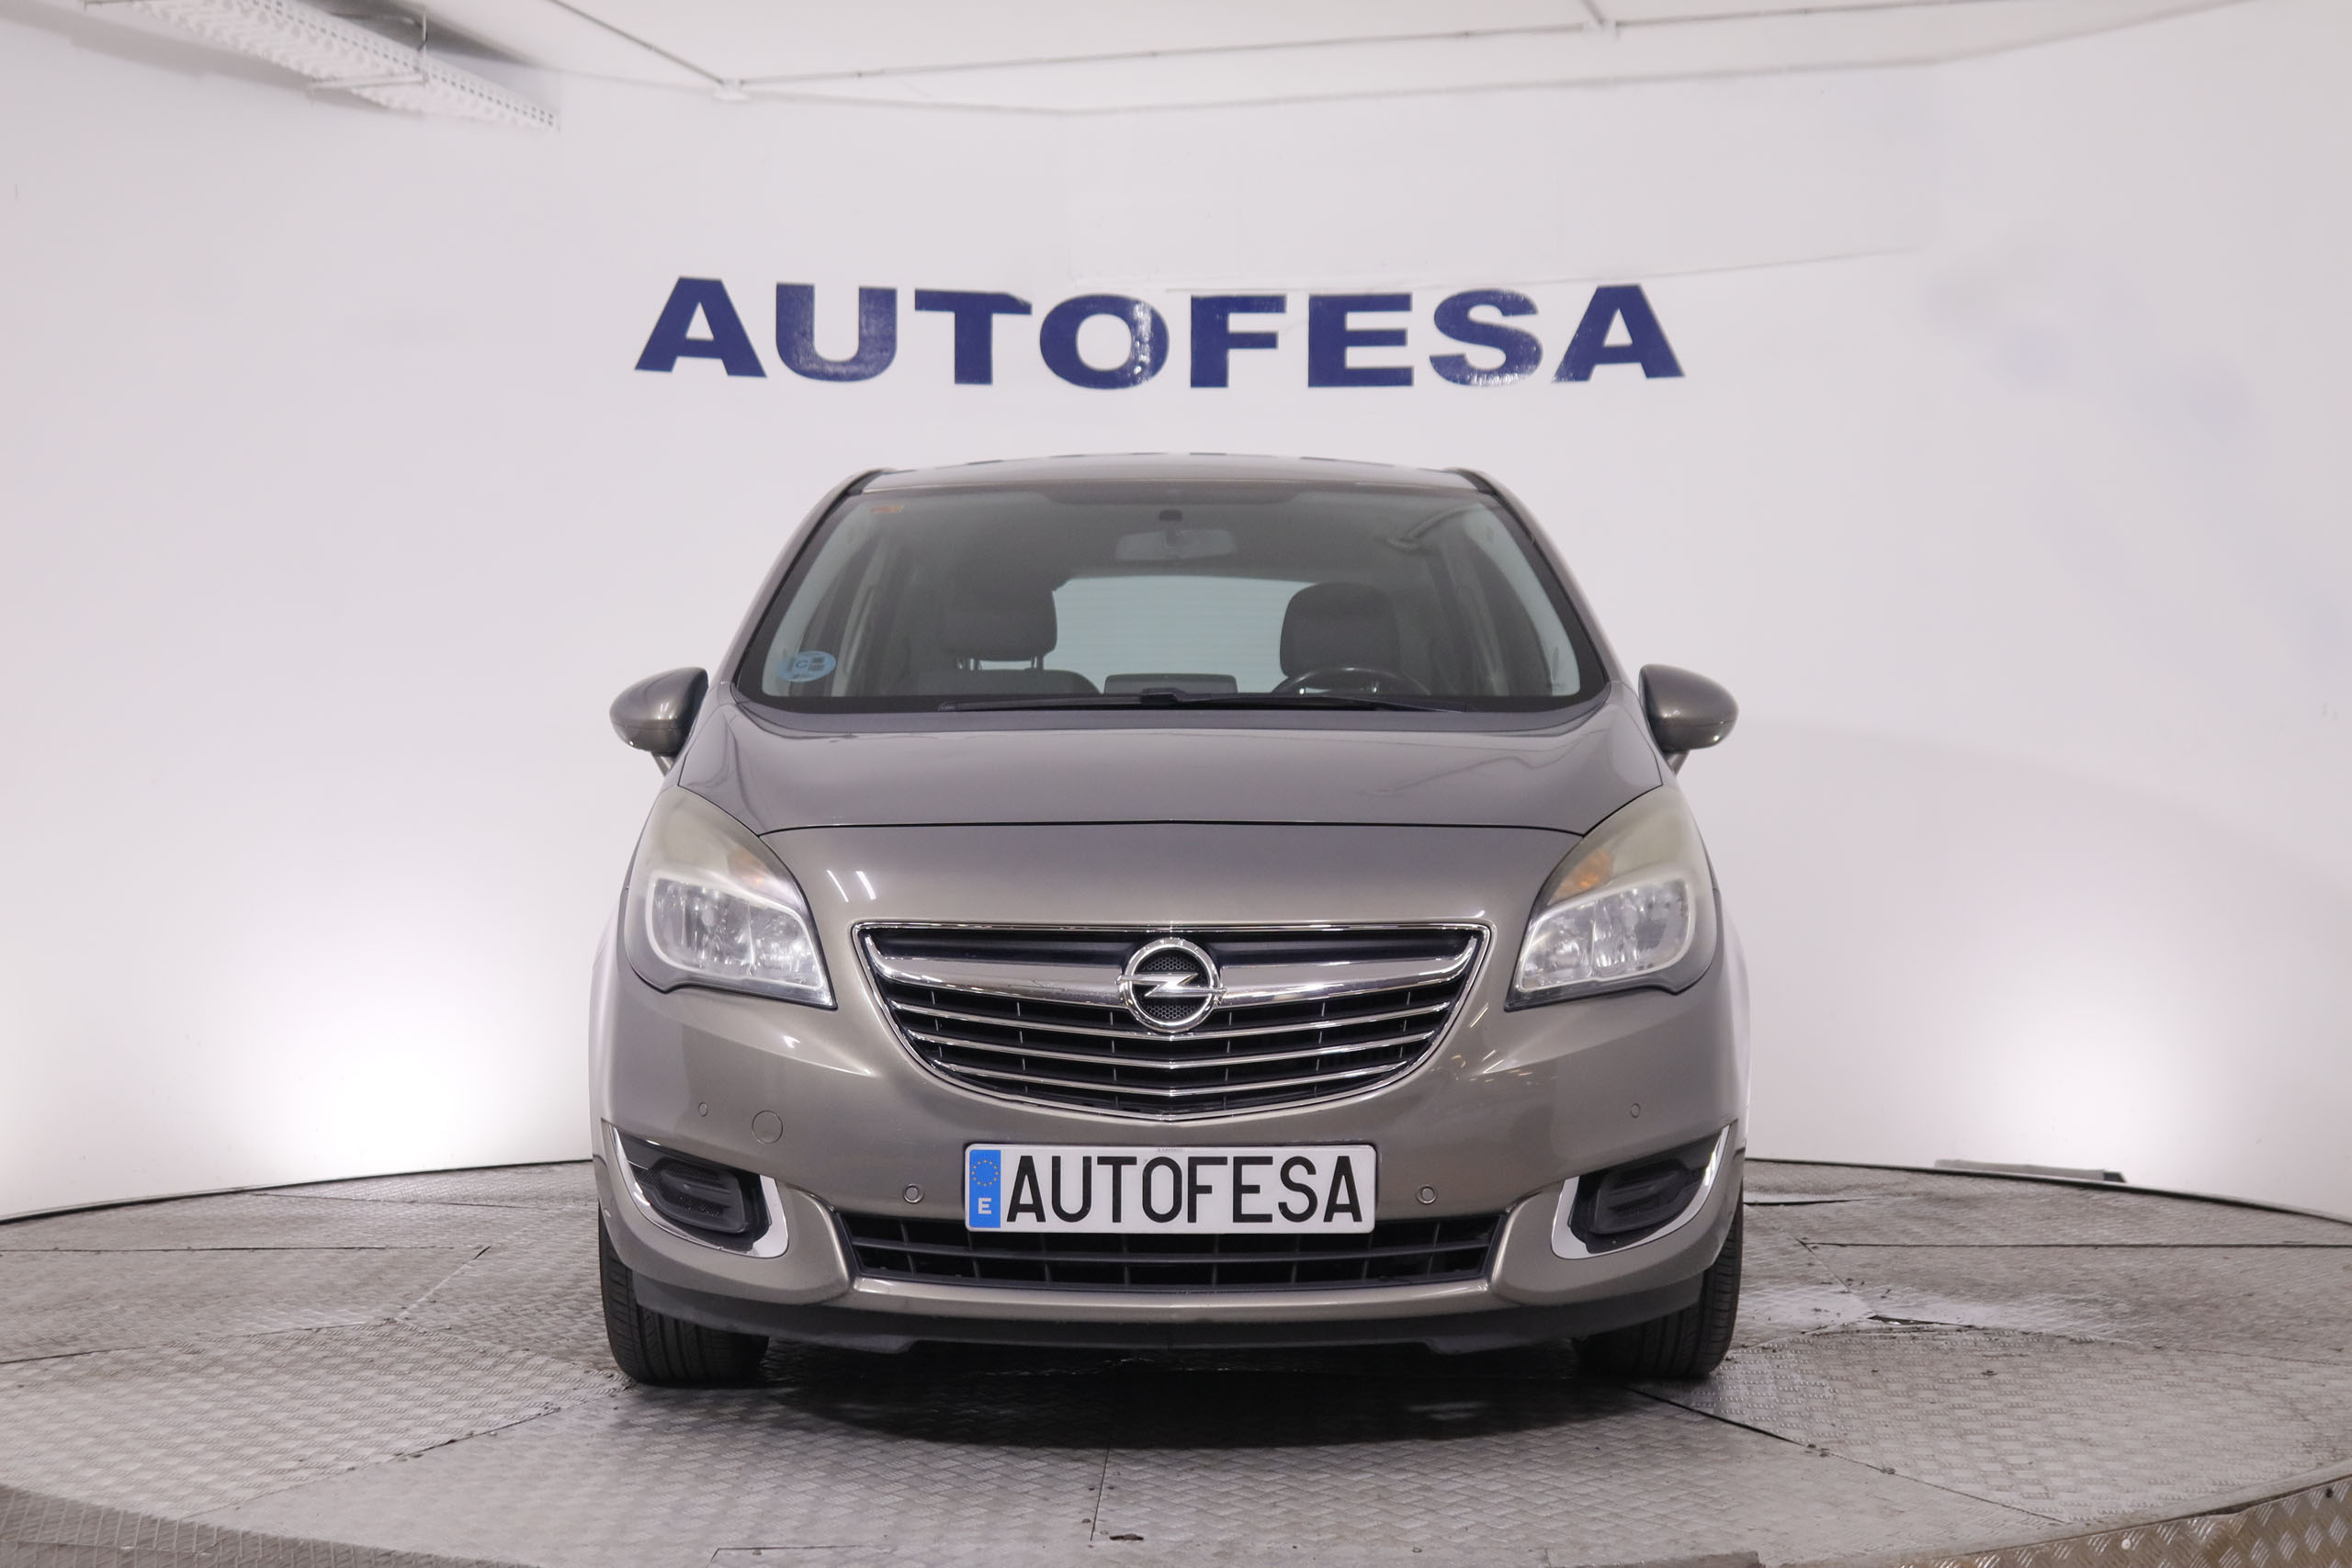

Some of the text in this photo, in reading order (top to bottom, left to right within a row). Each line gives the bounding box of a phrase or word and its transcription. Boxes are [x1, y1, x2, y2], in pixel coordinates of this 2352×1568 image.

[635, 277, 1685, 390] AUTOFESA
[978, 1197, 992, 1215] E
[1006, 1155, 1363, 1224] AUTOFESA
